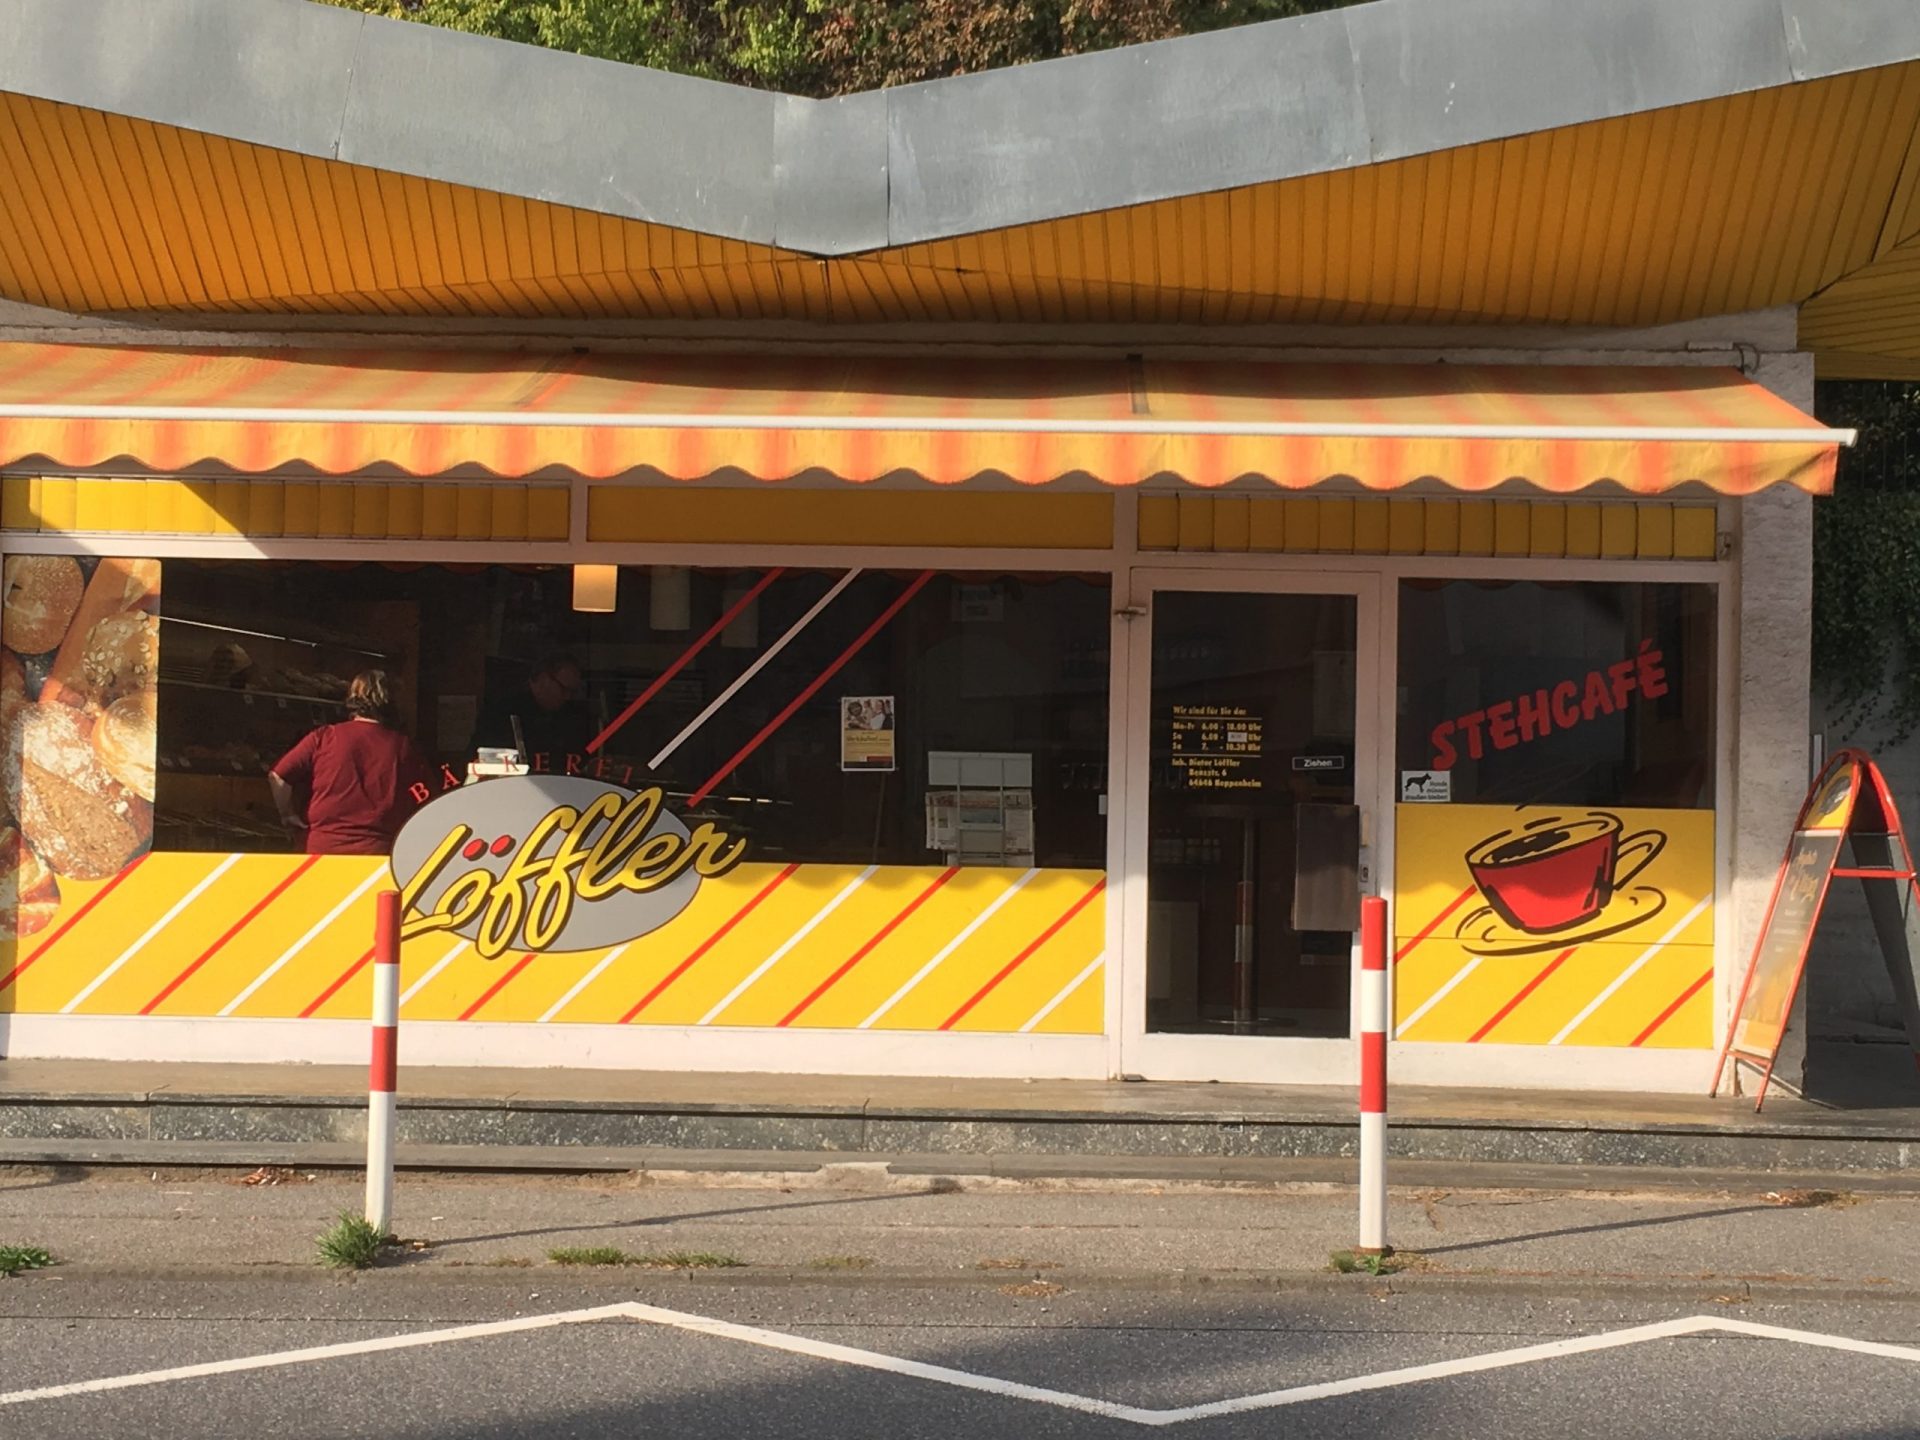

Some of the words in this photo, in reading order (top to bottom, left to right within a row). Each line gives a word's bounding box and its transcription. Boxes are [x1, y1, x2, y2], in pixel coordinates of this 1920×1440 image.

[1431, 638, 1669, 772] STEHCAFÉ
[1173, 706, 1187, 714] Wir
[1188, 706, 1205, 714] sind
[1206, 706, 1218, 714] für
[1220, 707, 1232, 715] Sie
[1248, 723, 1262, 731] Uhr
[1248, 733, 1262, 741] Uhr
[1247, 743, 1261, 751] Uhr
[1189, 758, 1212, 766] Dieter
[1214, 758, 1240, 767] Löffler
[1303, 759, 1332, 767] Ziehen
[1221, 768, 1227, 776] 6
[408, 752, 633, 804] BÄCKEREI
[1215, 779, 1261, 788] Heppenheim
[401, 786, 746, 960] Löffler
